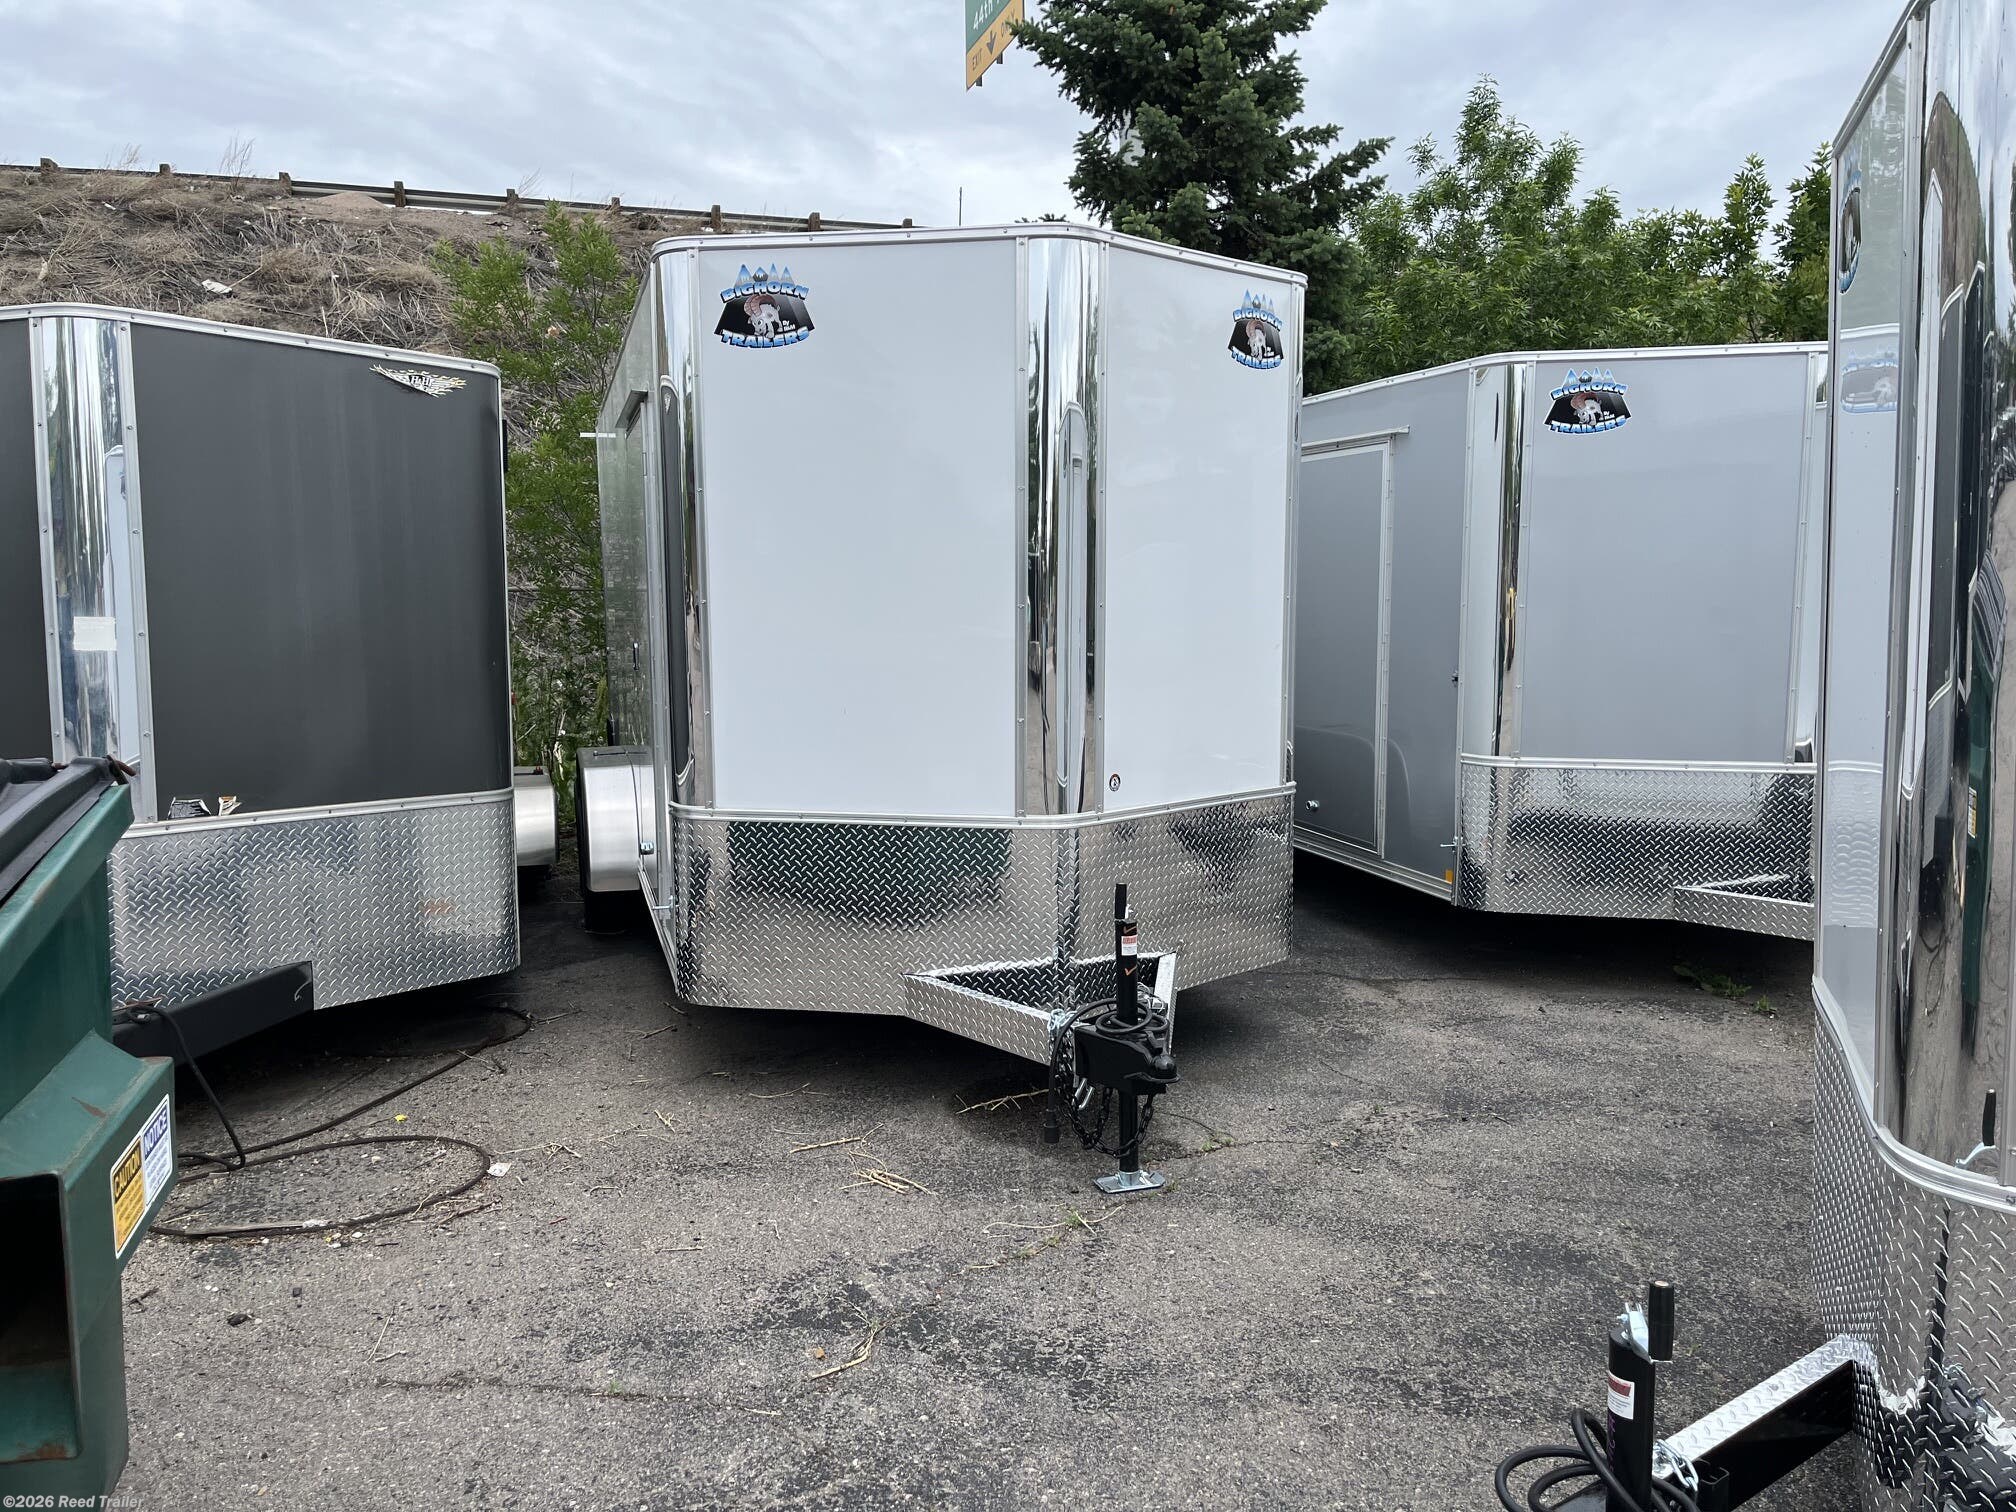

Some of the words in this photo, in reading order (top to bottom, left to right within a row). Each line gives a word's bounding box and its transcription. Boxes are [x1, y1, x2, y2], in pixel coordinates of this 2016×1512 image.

[720, 326, 810, 349] TRAILERS
[1231, 346, 1282, 370] TRAILERS
[1549, 416, 1627, 434] TRAILERS
[144, 1108, 167, 1156] NOTICE
[114, 1146, 140, 1198] CAUTION
